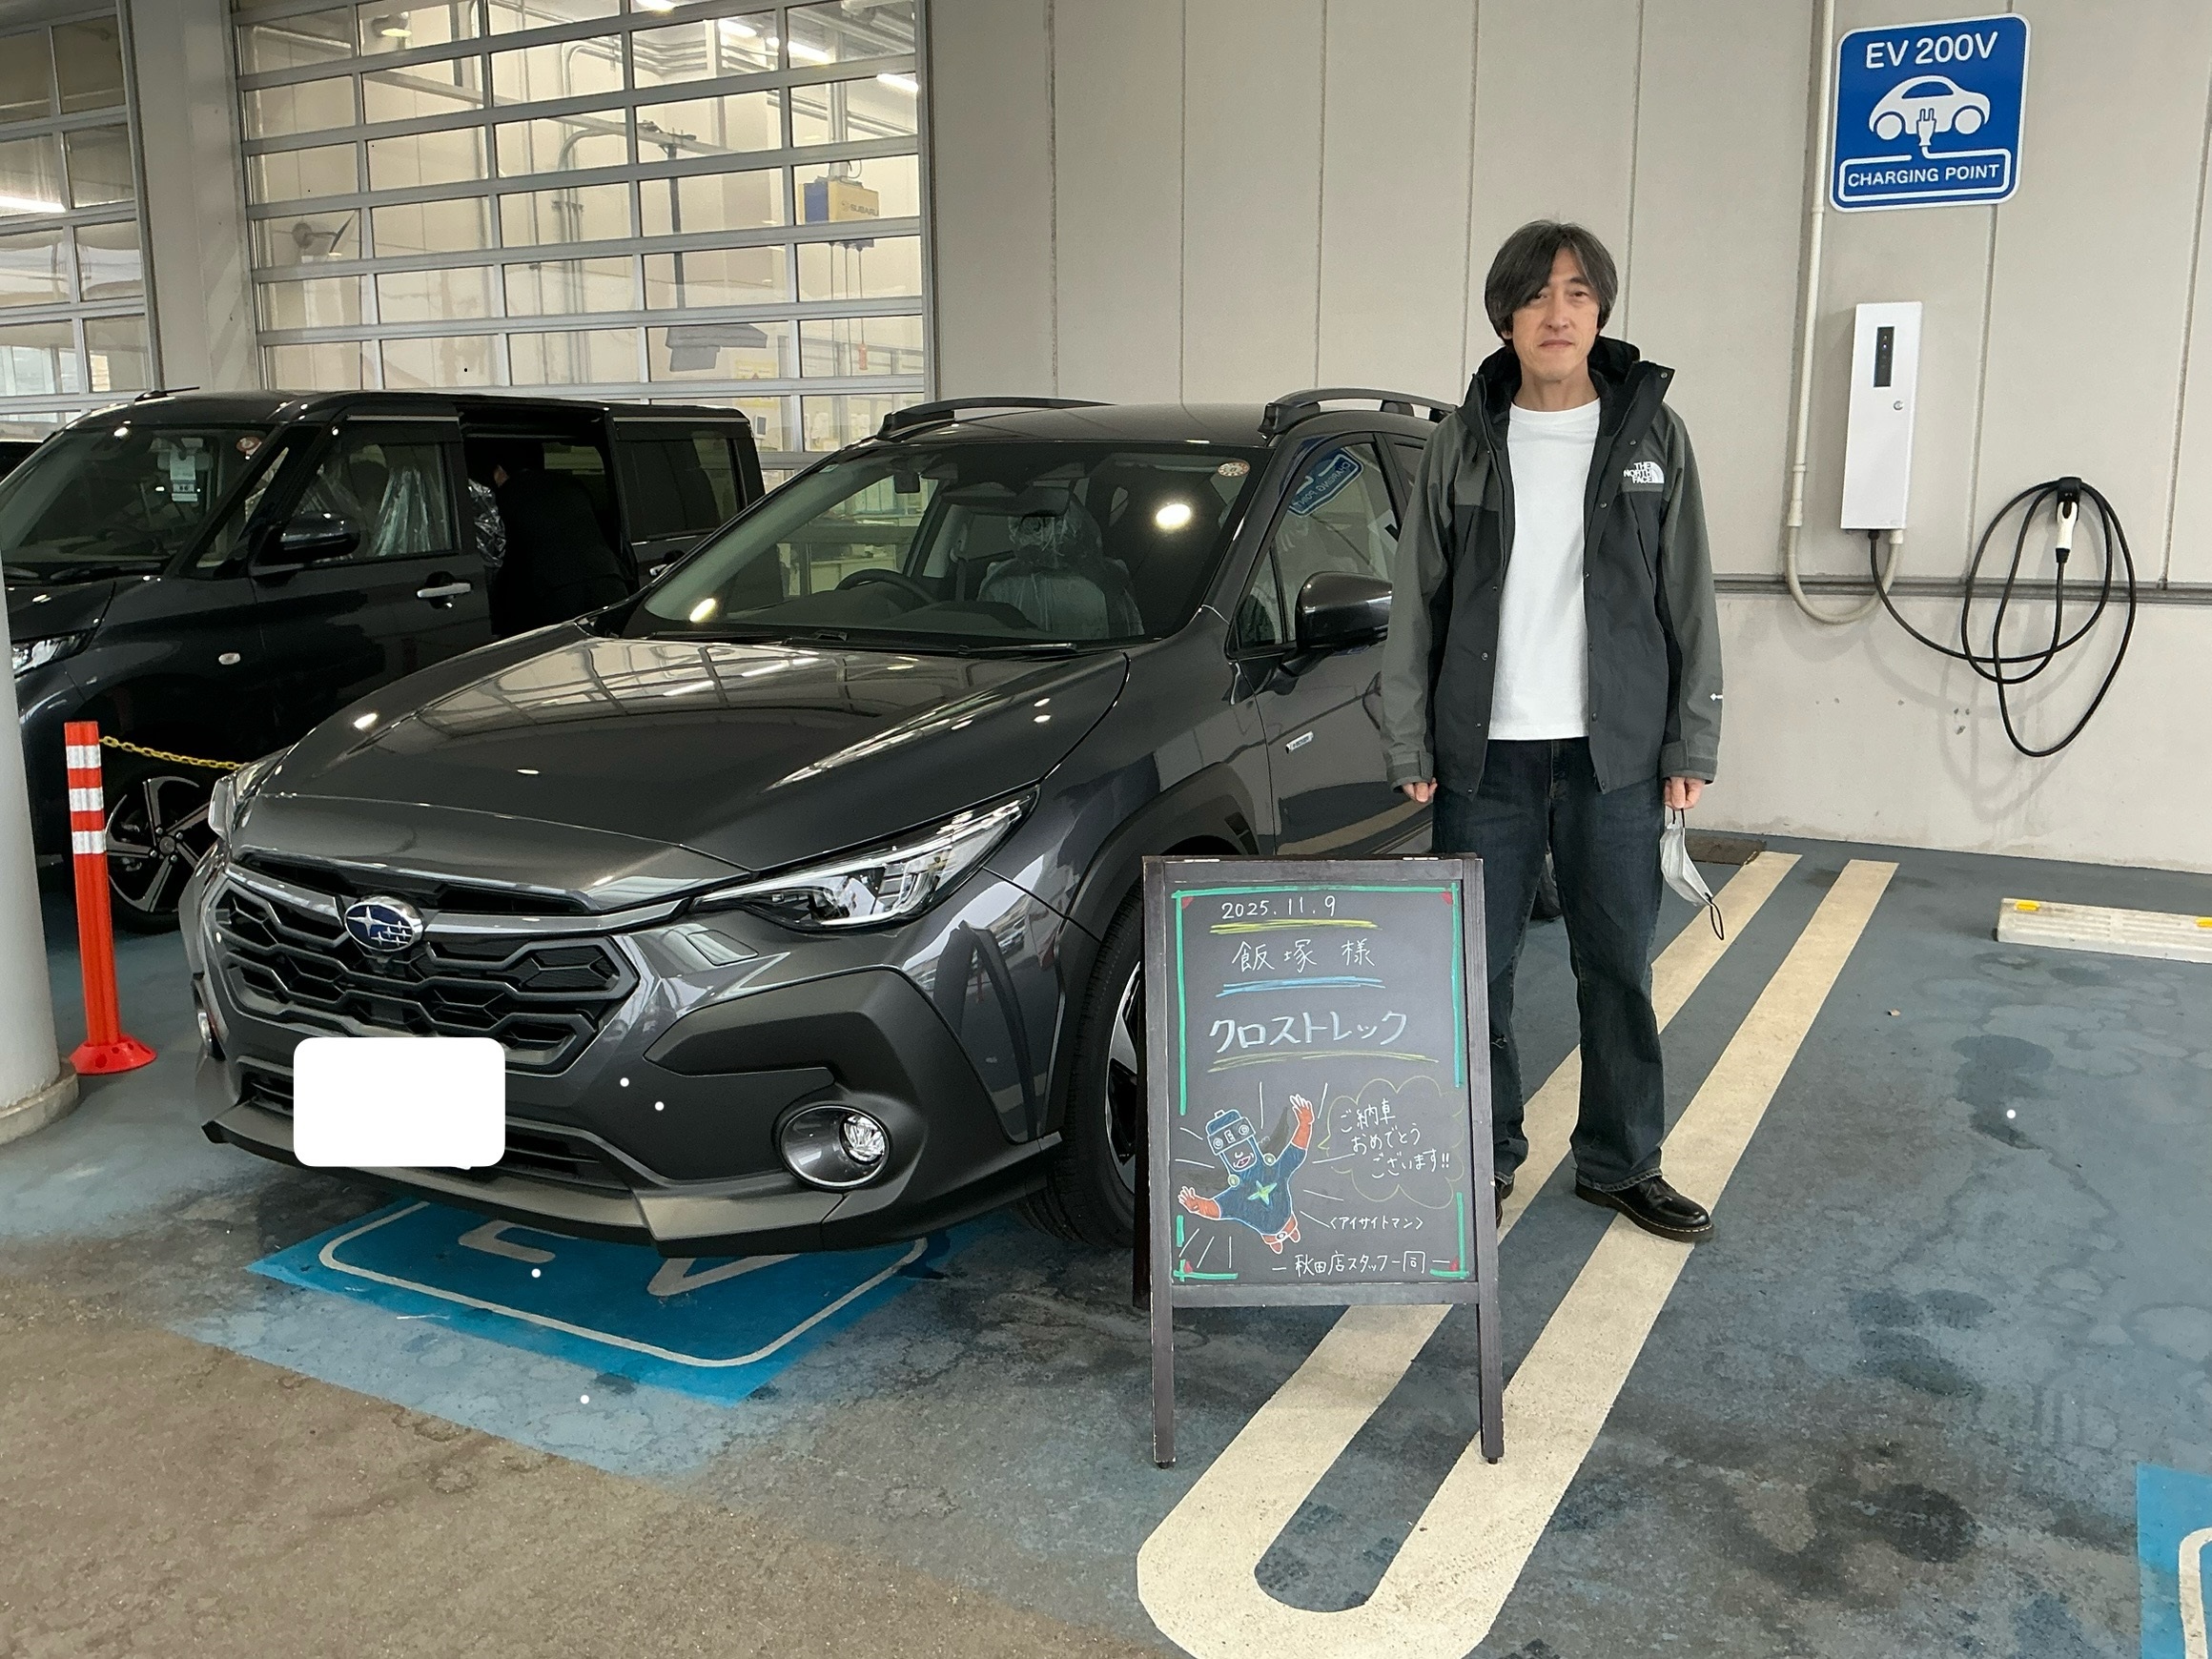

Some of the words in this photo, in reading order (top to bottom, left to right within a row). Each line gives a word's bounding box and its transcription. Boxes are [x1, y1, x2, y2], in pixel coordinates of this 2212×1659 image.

[1865, 40, 1910, 69] EV
[1915, 31, 1998, 65] 200V
[1847, 168, 1939, 188] CHARGING
[1945, 163, 2000, 181] POINT
[850, 203, 879, 217] SUBARU
[1623, 469, 1651, 478] NORTH
[1633, 461, 1651, 470] THE
[1208, 1010, 1408, 1053] クロストレック
[1340, 1098, 1396, 1134] ご納車
[1350, 1122, 1422, 1156] おめでとう
